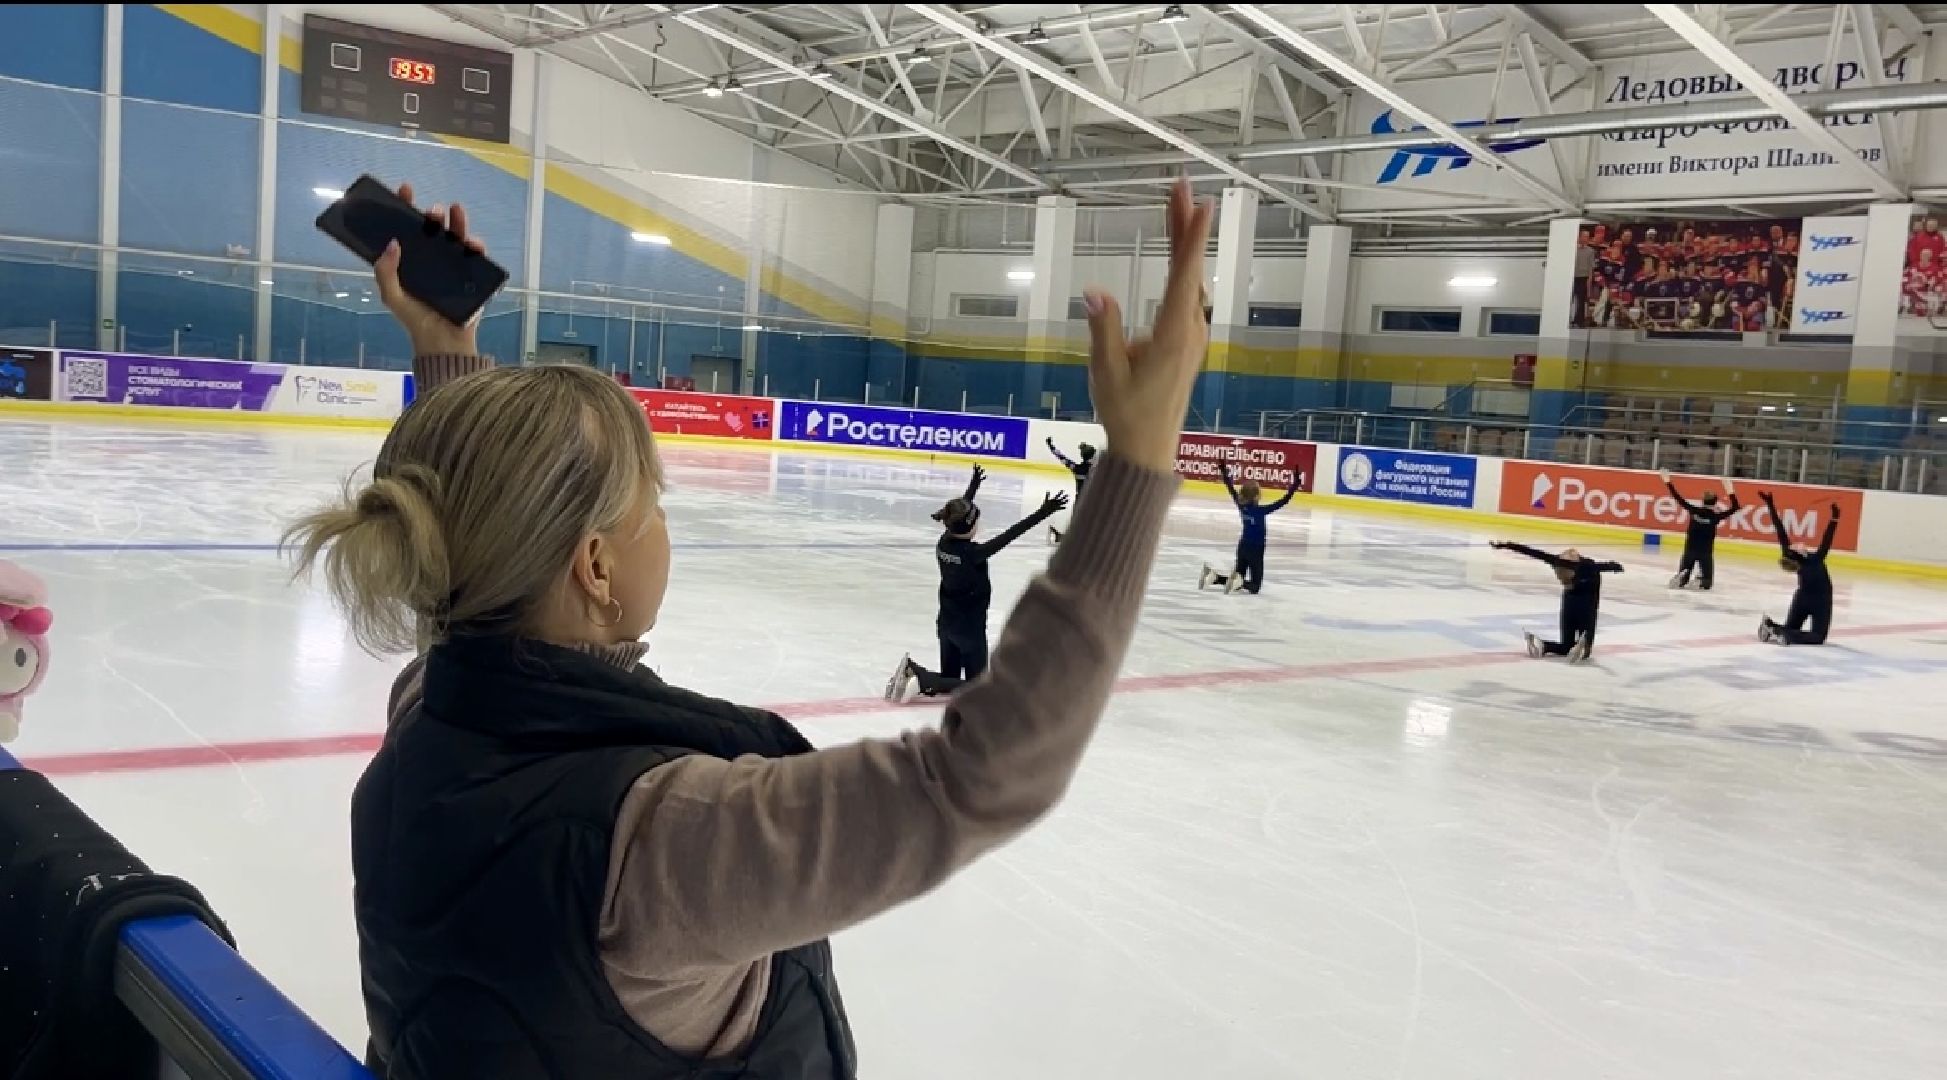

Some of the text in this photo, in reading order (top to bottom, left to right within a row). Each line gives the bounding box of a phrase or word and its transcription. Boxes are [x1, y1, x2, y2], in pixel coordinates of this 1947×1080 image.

[1605, 57, 1907, 104] Ледовы дворц
[1596, 161, 1665, 177] имени
[1669, 155, 1759, 177] Виктора
[827, 412, 1005, 451] Ростелеком
[1180, 443, 1286, 466] ПРАВИТЕЛЬСТВО
[1430, 484, 1468, 499] России
